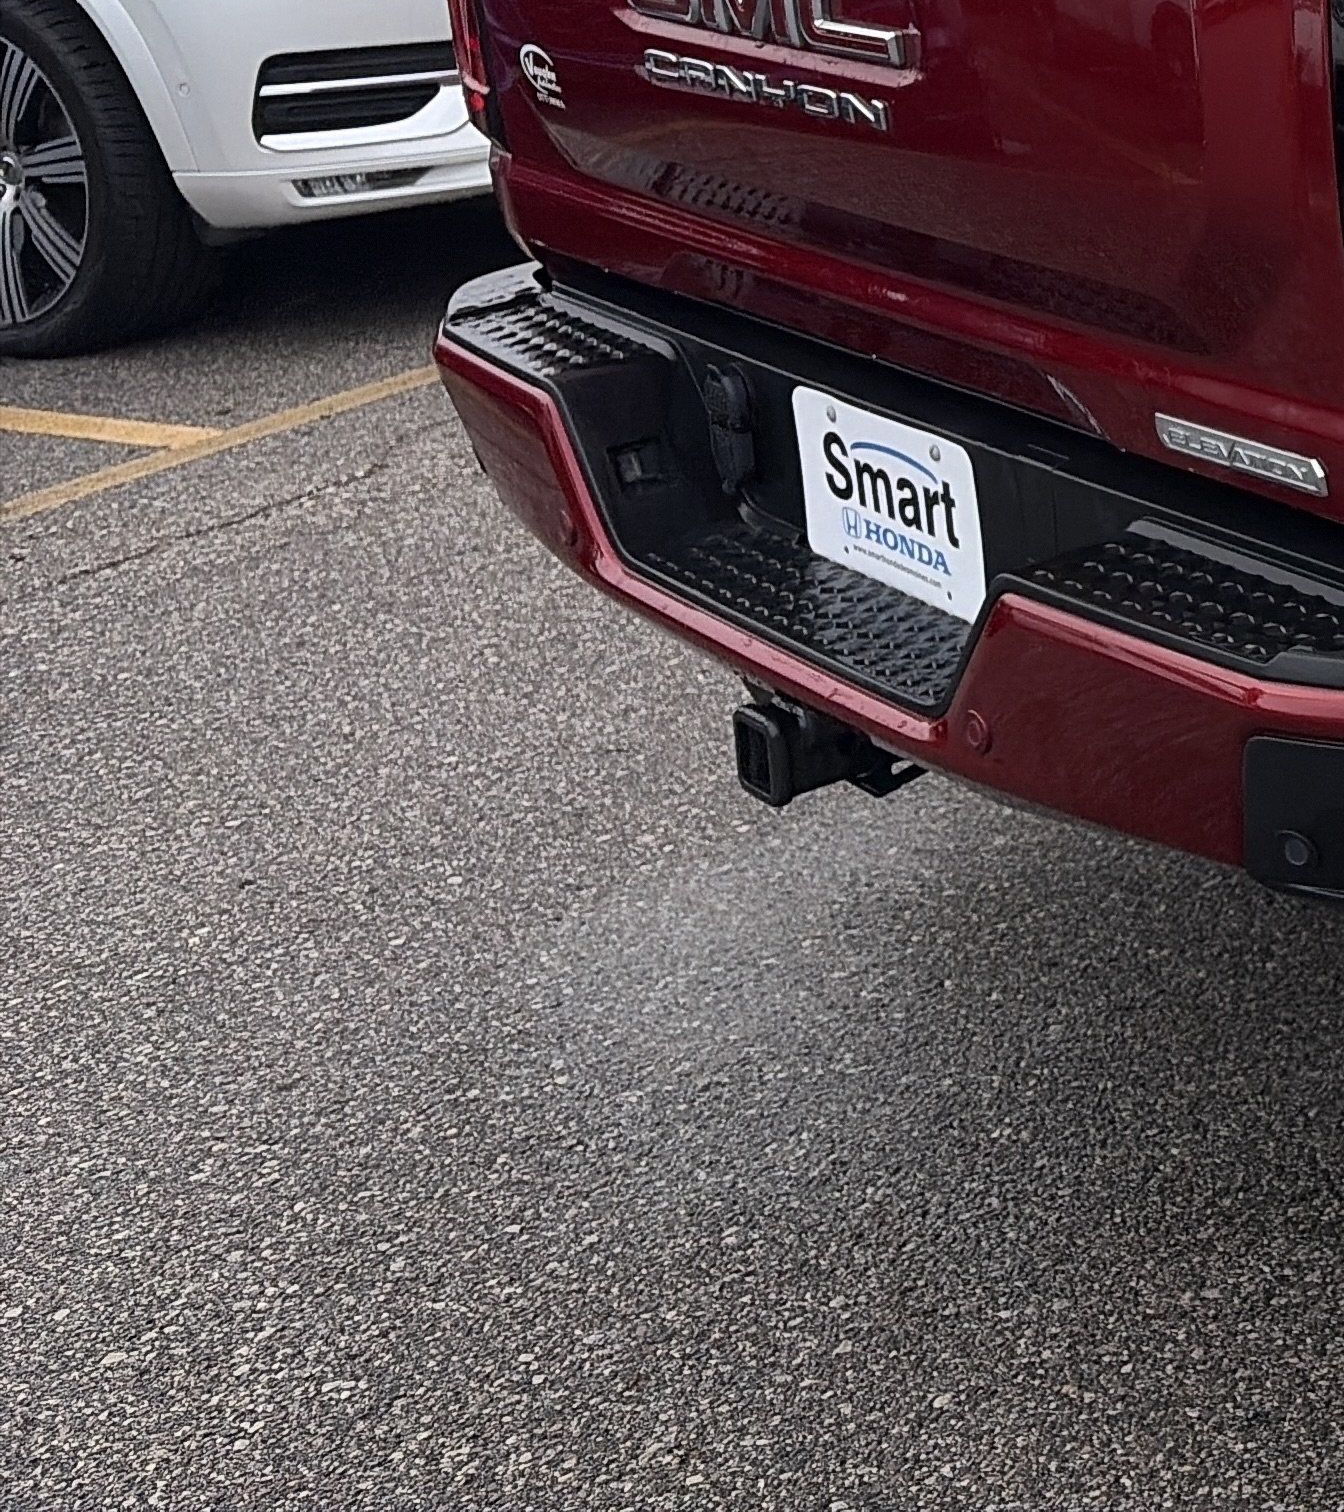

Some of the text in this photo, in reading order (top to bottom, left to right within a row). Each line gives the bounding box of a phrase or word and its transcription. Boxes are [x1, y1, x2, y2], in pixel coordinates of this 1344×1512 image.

[643, 48, 890, 132] CANYON
[823, 431, 960, 550] Smart
[863, 518, 952, 577] HONDA
